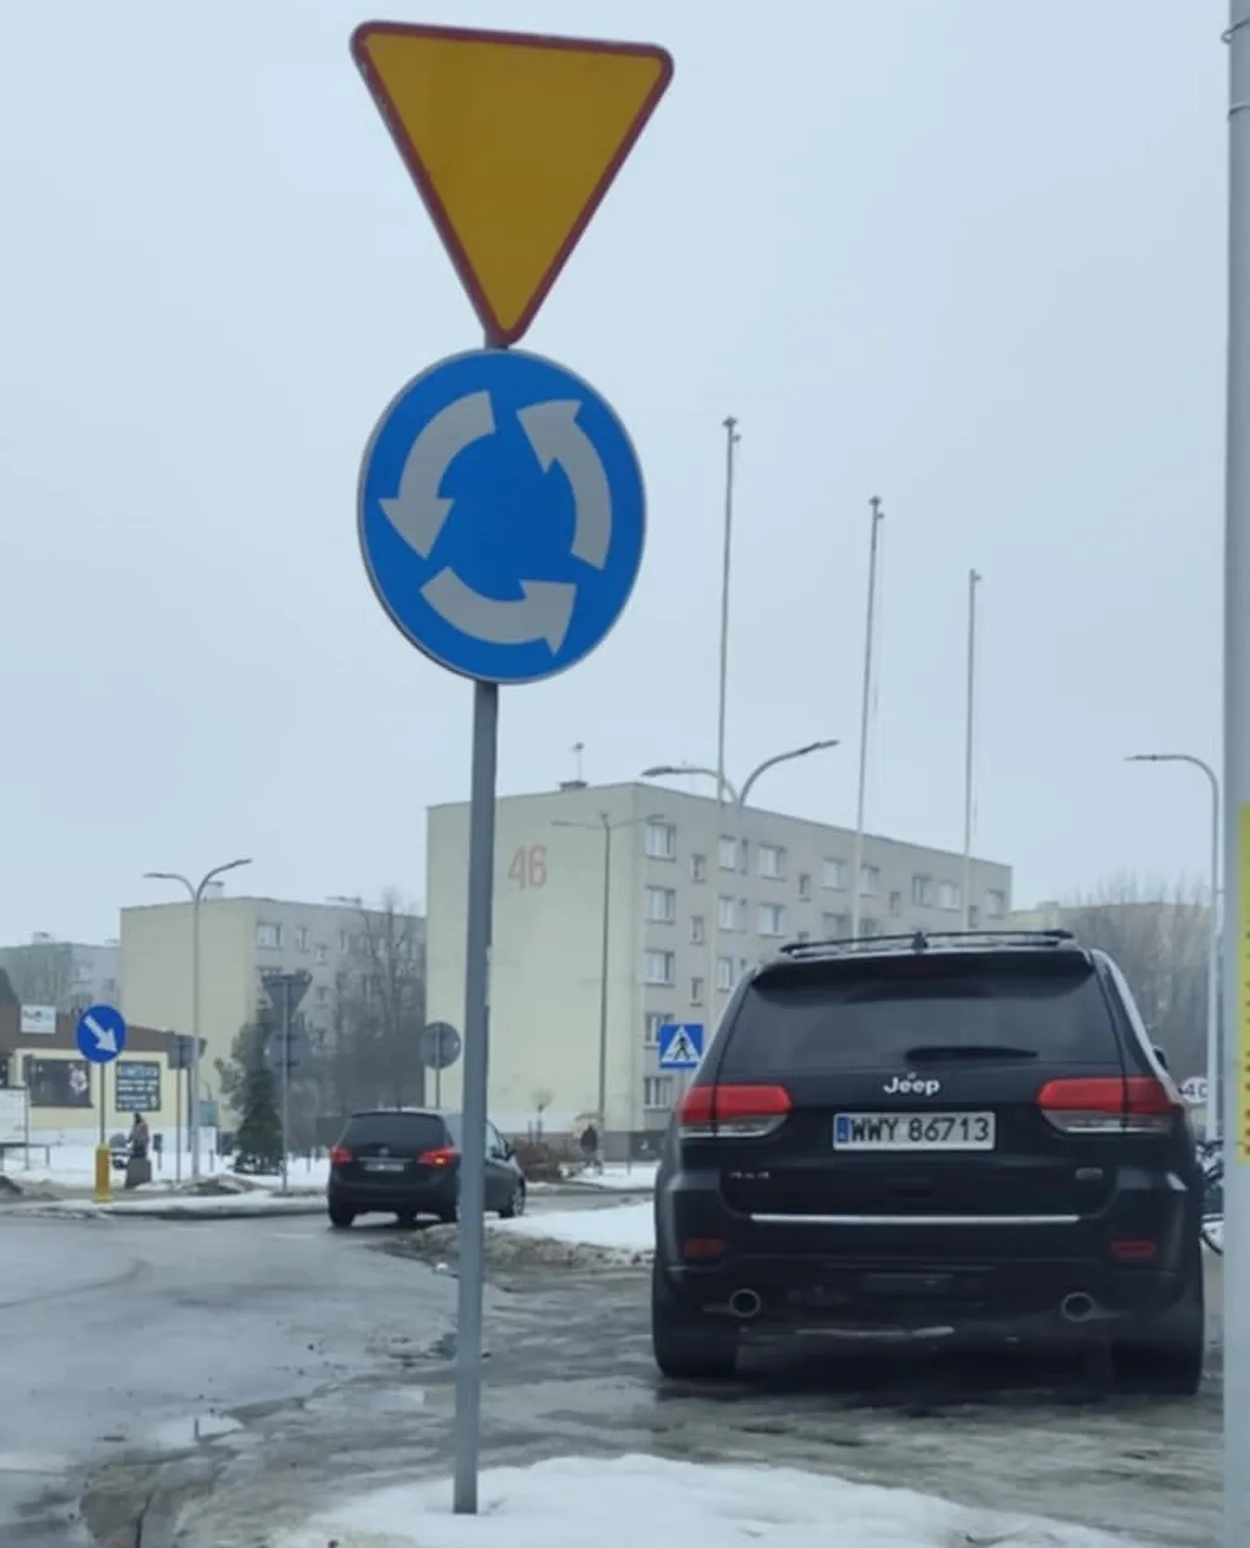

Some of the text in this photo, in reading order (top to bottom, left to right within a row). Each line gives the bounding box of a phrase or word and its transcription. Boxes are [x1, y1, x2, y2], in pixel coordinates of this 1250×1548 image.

[507, 844, 548, 891] 46
[882, 1076, 941, 1096] Jeep
[851, 1116, 990, 1142] WWY 86713
